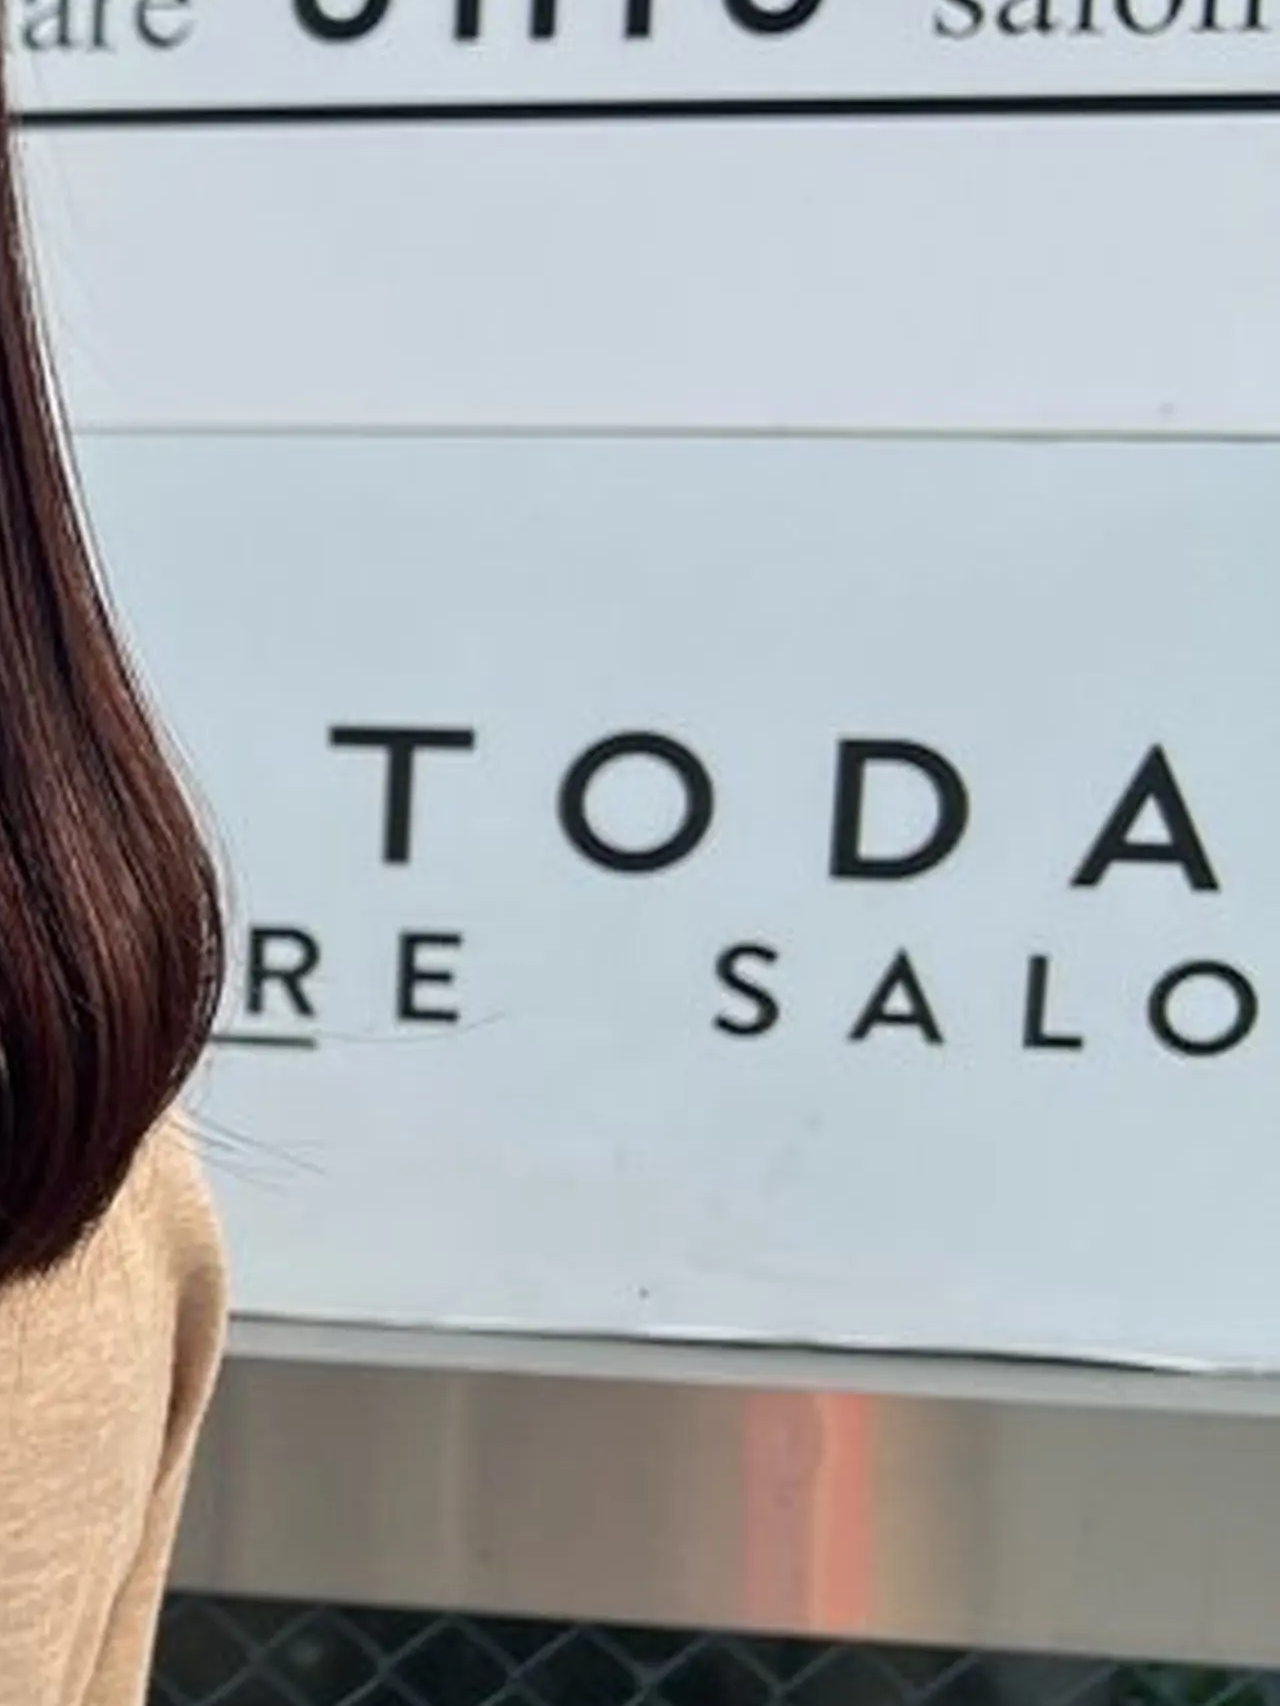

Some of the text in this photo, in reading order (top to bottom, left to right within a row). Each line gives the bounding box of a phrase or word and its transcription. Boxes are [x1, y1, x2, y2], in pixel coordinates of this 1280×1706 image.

[327, 724, 1221, 893] TODA
[245, 925, 1259, 1058] RE SALO
